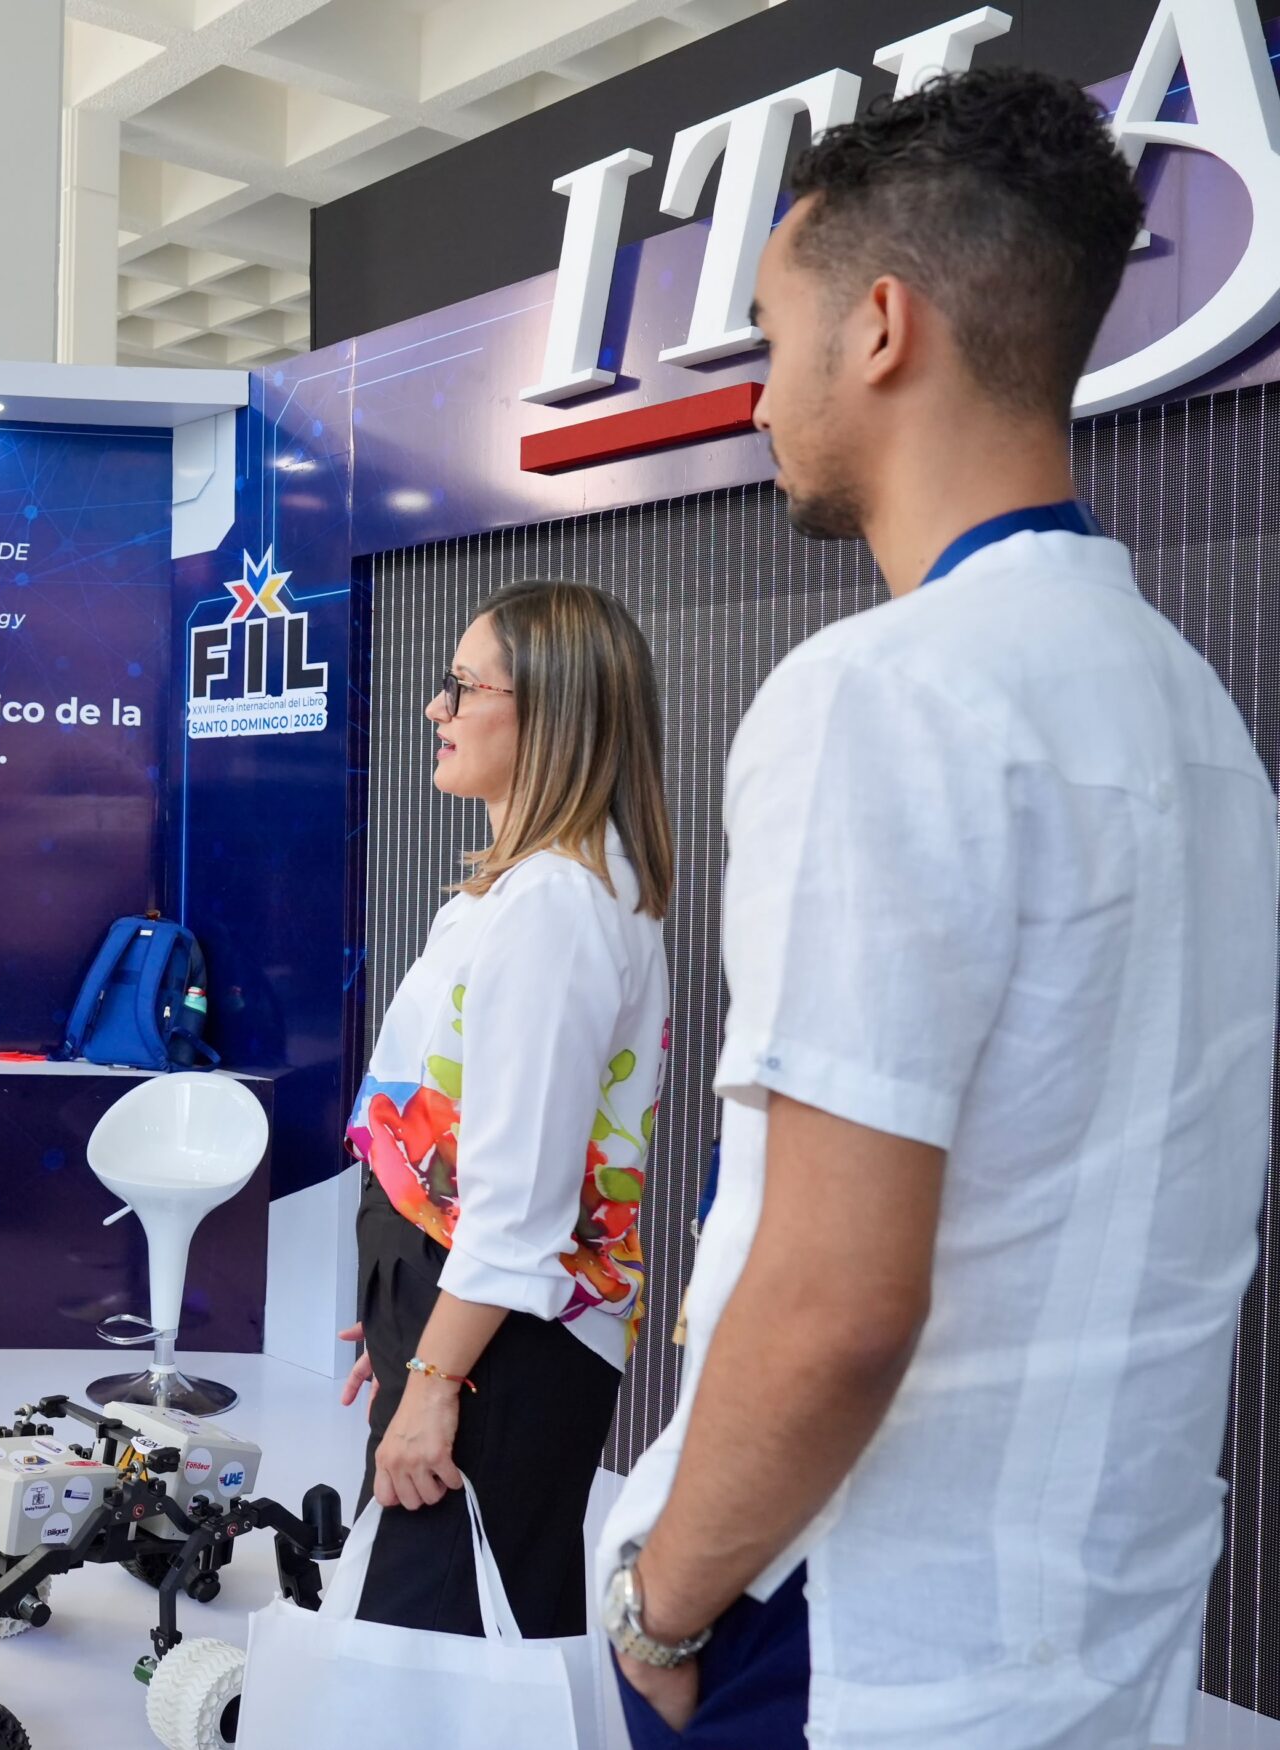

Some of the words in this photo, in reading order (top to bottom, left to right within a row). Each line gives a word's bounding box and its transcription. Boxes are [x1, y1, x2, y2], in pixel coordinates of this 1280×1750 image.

[190, 612, 328, 698] FIL
[55, 696, 101, 726] de
[112, 698, 142, 727] la
[192, 705, 215, 716] XXVIII
[216, 702, 235, 713] Feria
[288, 696, 301, 708] del
[302, 694, 324, 707] Libro
[191, 720, 228, 734] SANTO
[231, 715, 289, 732] DOMINGO
[293, 712, 324, 728] 2026
[185, 1460, 211, 1471] Fondeur
